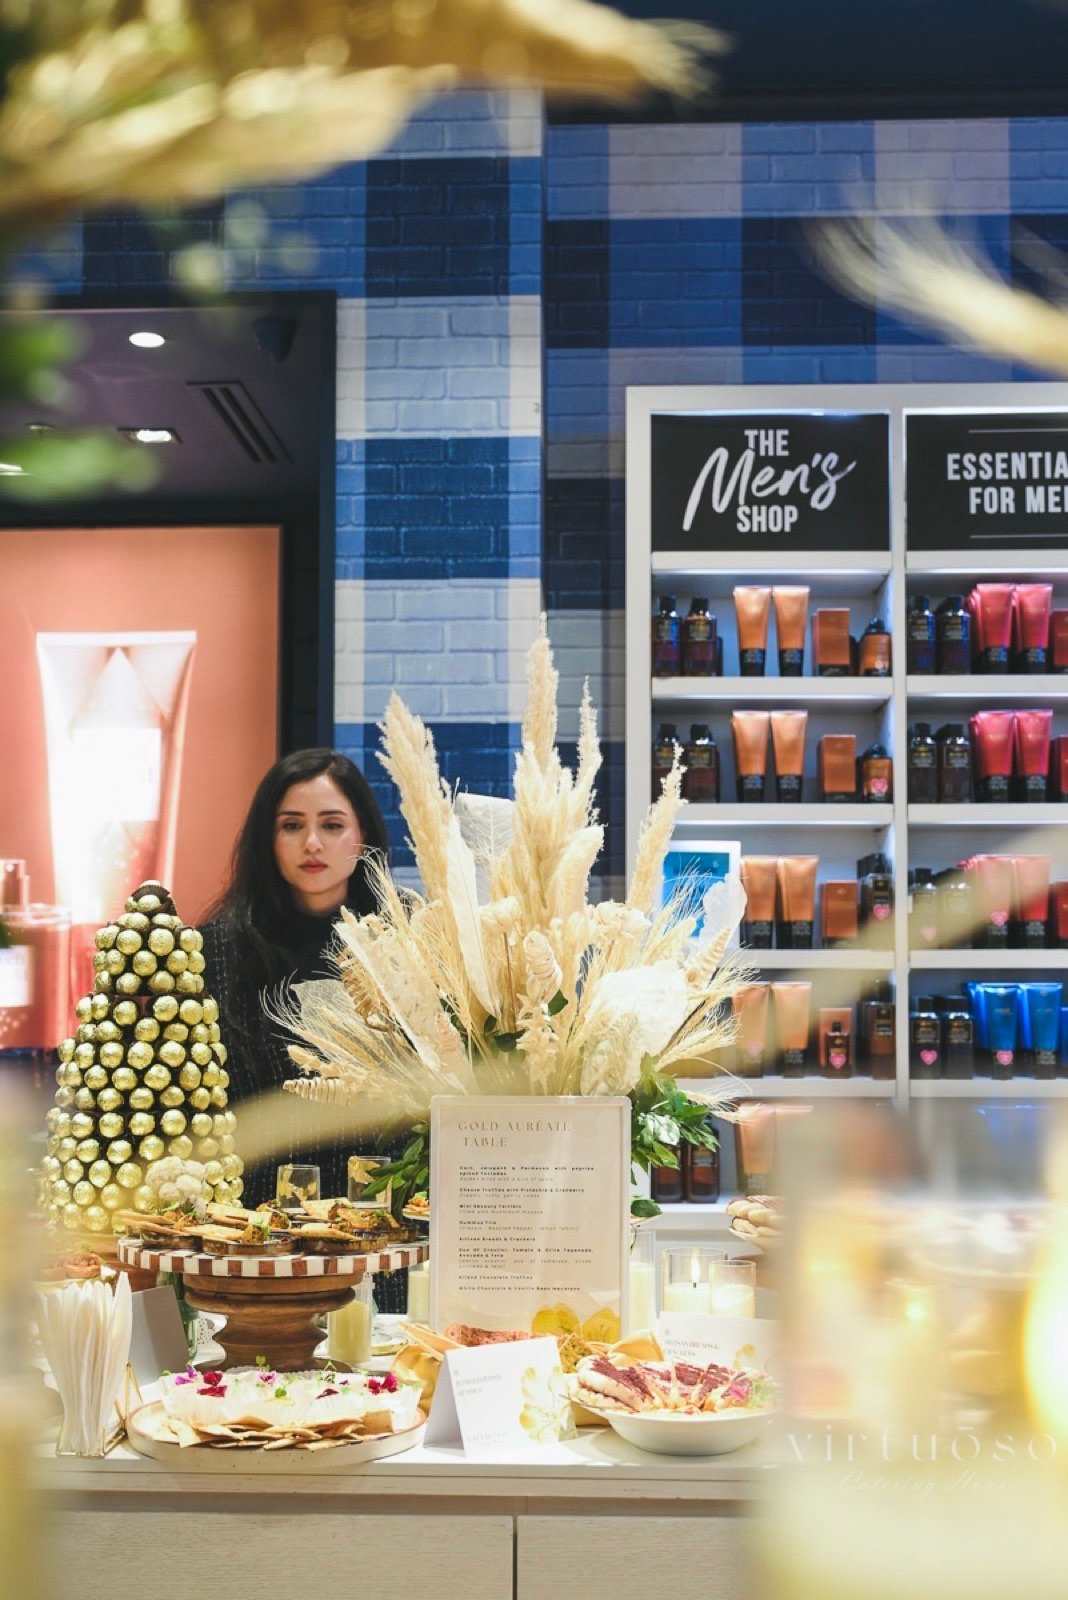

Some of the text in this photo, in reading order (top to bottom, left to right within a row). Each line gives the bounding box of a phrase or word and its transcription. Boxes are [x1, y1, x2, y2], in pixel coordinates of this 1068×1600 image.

[744, 429, 790, 456] THE
[946, 451, 1068, 480] ESSENTIA
[683, 447, 858, 531] Men's
[968, 486, 1016, 514] FOR
[736, 504, 799, 532] SHOP
[458, 1120, 500, 1132] GOLD
[463, 1136, 508, 1148] TABLE
